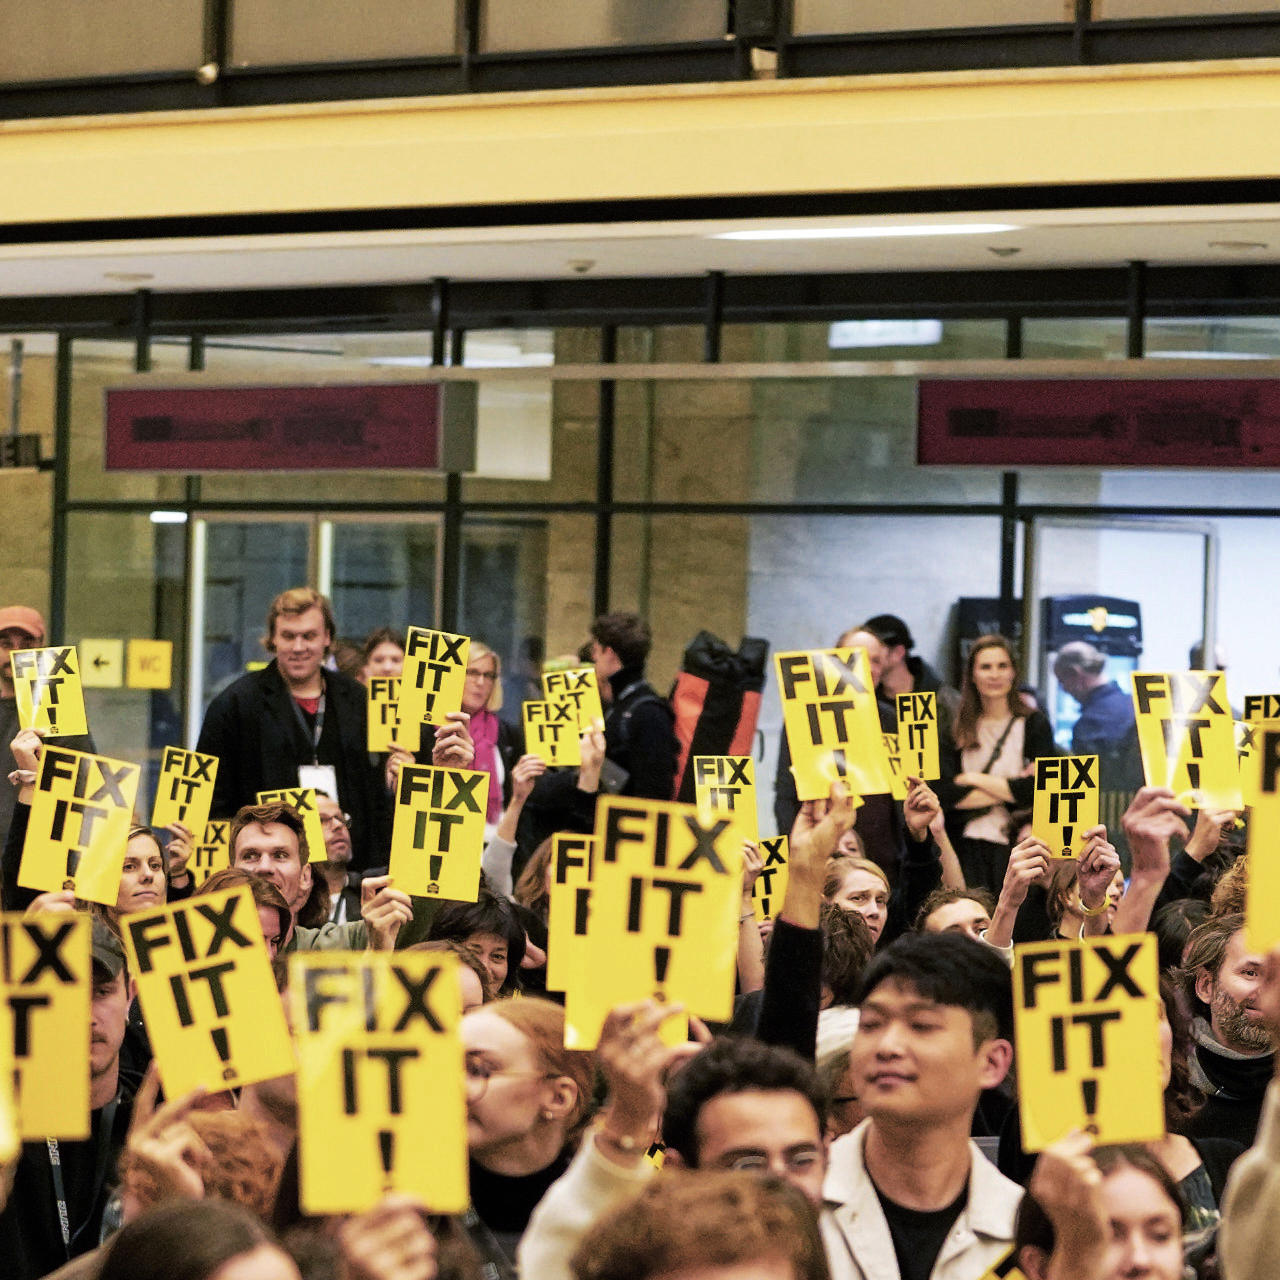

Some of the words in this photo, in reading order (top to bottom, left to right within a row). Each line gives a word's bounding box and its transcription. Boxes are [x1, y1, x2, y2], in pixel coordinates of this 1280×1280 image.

[15, 649, 76, 679] FIX
[139, 654, 162, 674] WC
[408, 630, 467, 665] FIX
[30, 678, 64, 706] IT
[416, 662, 451, 692] IT
[547, 670, 592, 692] FIX
[779, 653, 869, 700] FIX
[1134, 675, 1226, 714] FIX
[47, 707, 59, 735] !
[424, 693, 436, 721] !
[527, 702, 572, 722] FIX
[806, 701, 855, 745] IT
[899, 694, 934, 722] FIX
[539, 724, 563, 742] IT
[908, 724, 929, 750] IT
[1161, 719, 1211, 757] IT
[40, 752, 132, 810] FIX
[164, 753, 216, 782] FIX
[696, 758, 752, 786] FIX
[1036, 758, 1096, 791] FIX
[170, 778, 201, 805] IT
[400, 766, 487, 813] FIX
[710, 788, 741, 811] IT
[50, 801, 108, 848] IT
[1049, 792, 1086, 824] IT
[413, 810, 463, 852] IT
[604, 807, 731, 875] FIX
[1061, 826, 1073, 856] !
[63, 849, 79, 891] !
[197, 847, 219, 867] IT
[427, 855, 443, 894] !
[628, 877, 702, 937] IT
[128, 896, 254, 973] FIX
[1020, 943, 1146, 1009] FIX
[169, 961, 235, 1028] IT
[303, 965, 447, 1033] FIX
[210, 1028, 238, 1081] !
[1048, 1010, 1122, 1073] IT
[342, 1048, 420, 1115] IT
[1081, 1079, 1100, 1134] !
